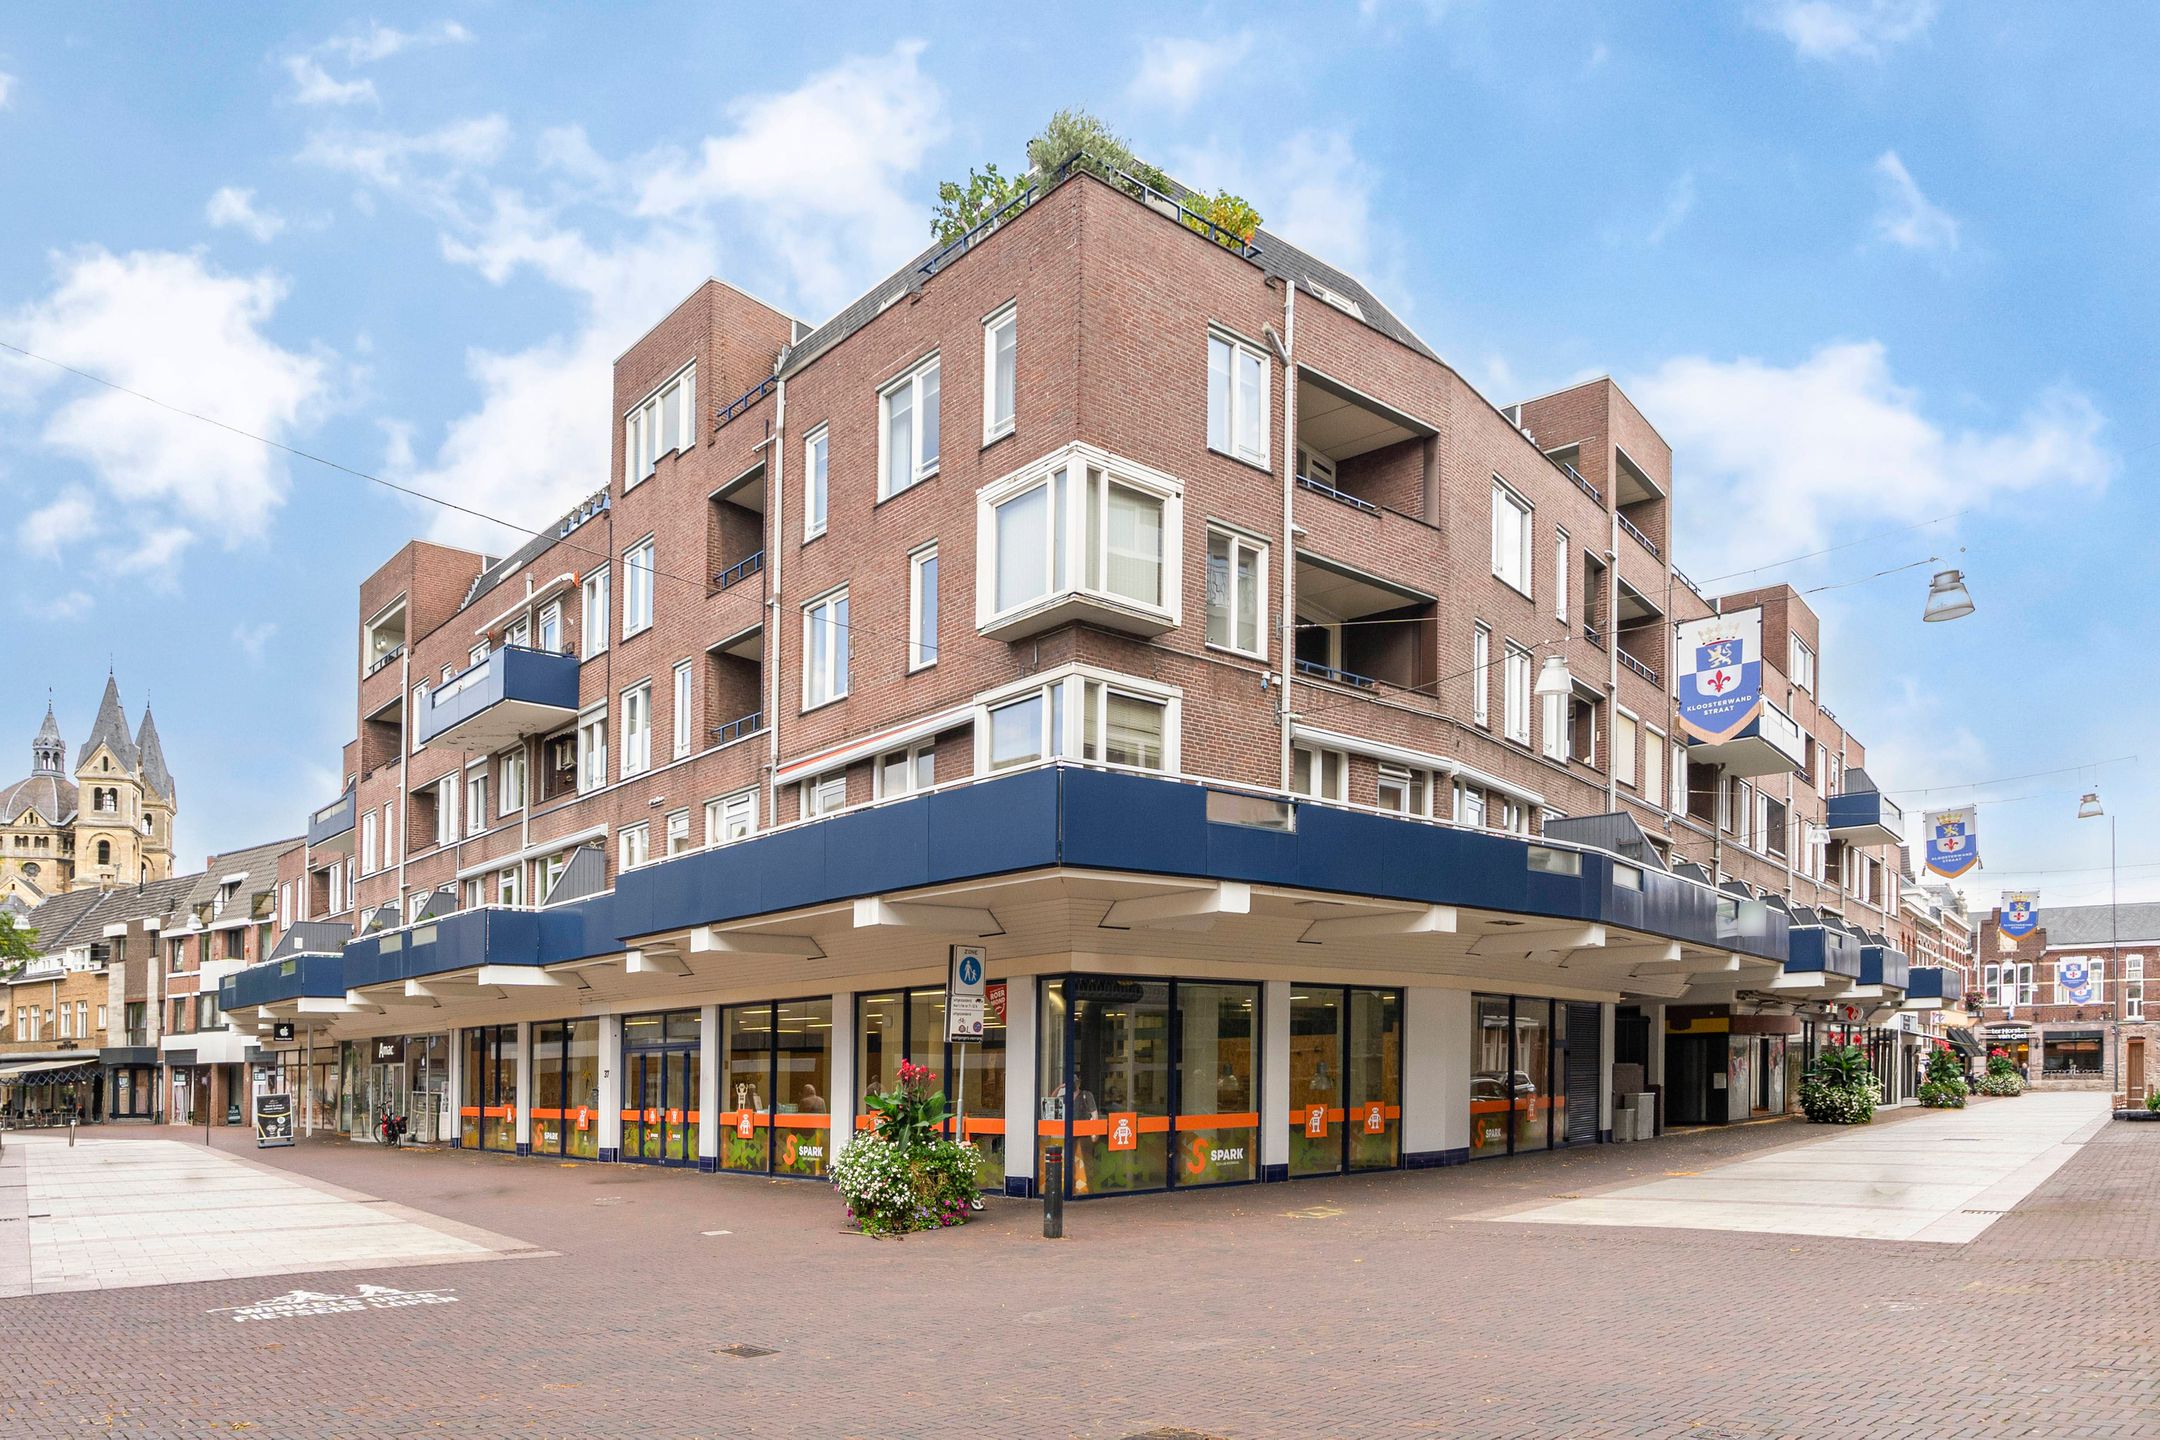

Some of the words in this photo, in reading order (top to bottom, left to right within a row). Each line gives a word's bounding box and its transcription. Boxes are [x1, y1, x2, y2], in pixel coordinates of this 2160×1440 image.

[1687, 695, 1752, 712] KLOOSTERWAND
[1703, 706, 1734, 716] STRAAT
[990, 990, 1005, 1000] ROER
[378, 1042, 395, 1058] Amac
[604, 1070, 609, 1078] 37
[544, 1131, 559, 1140] SPARK
[1485, 1128, 1502, 1138] SPARK
[783, 1134, 798, 1165] S
[798, 1145, 823, 1157] SPARK
[1186, 1137, 1209, 1175] S
[1210, 1147, 1244, 1161] SPARK
[232, 1304, 368, 1323] FIETSERS
[371, 1296, 460, 1309] LOPEN
[234, 1300, 363, 1315] WINKELS
[366, 1292, 439, 1304] OPEN
